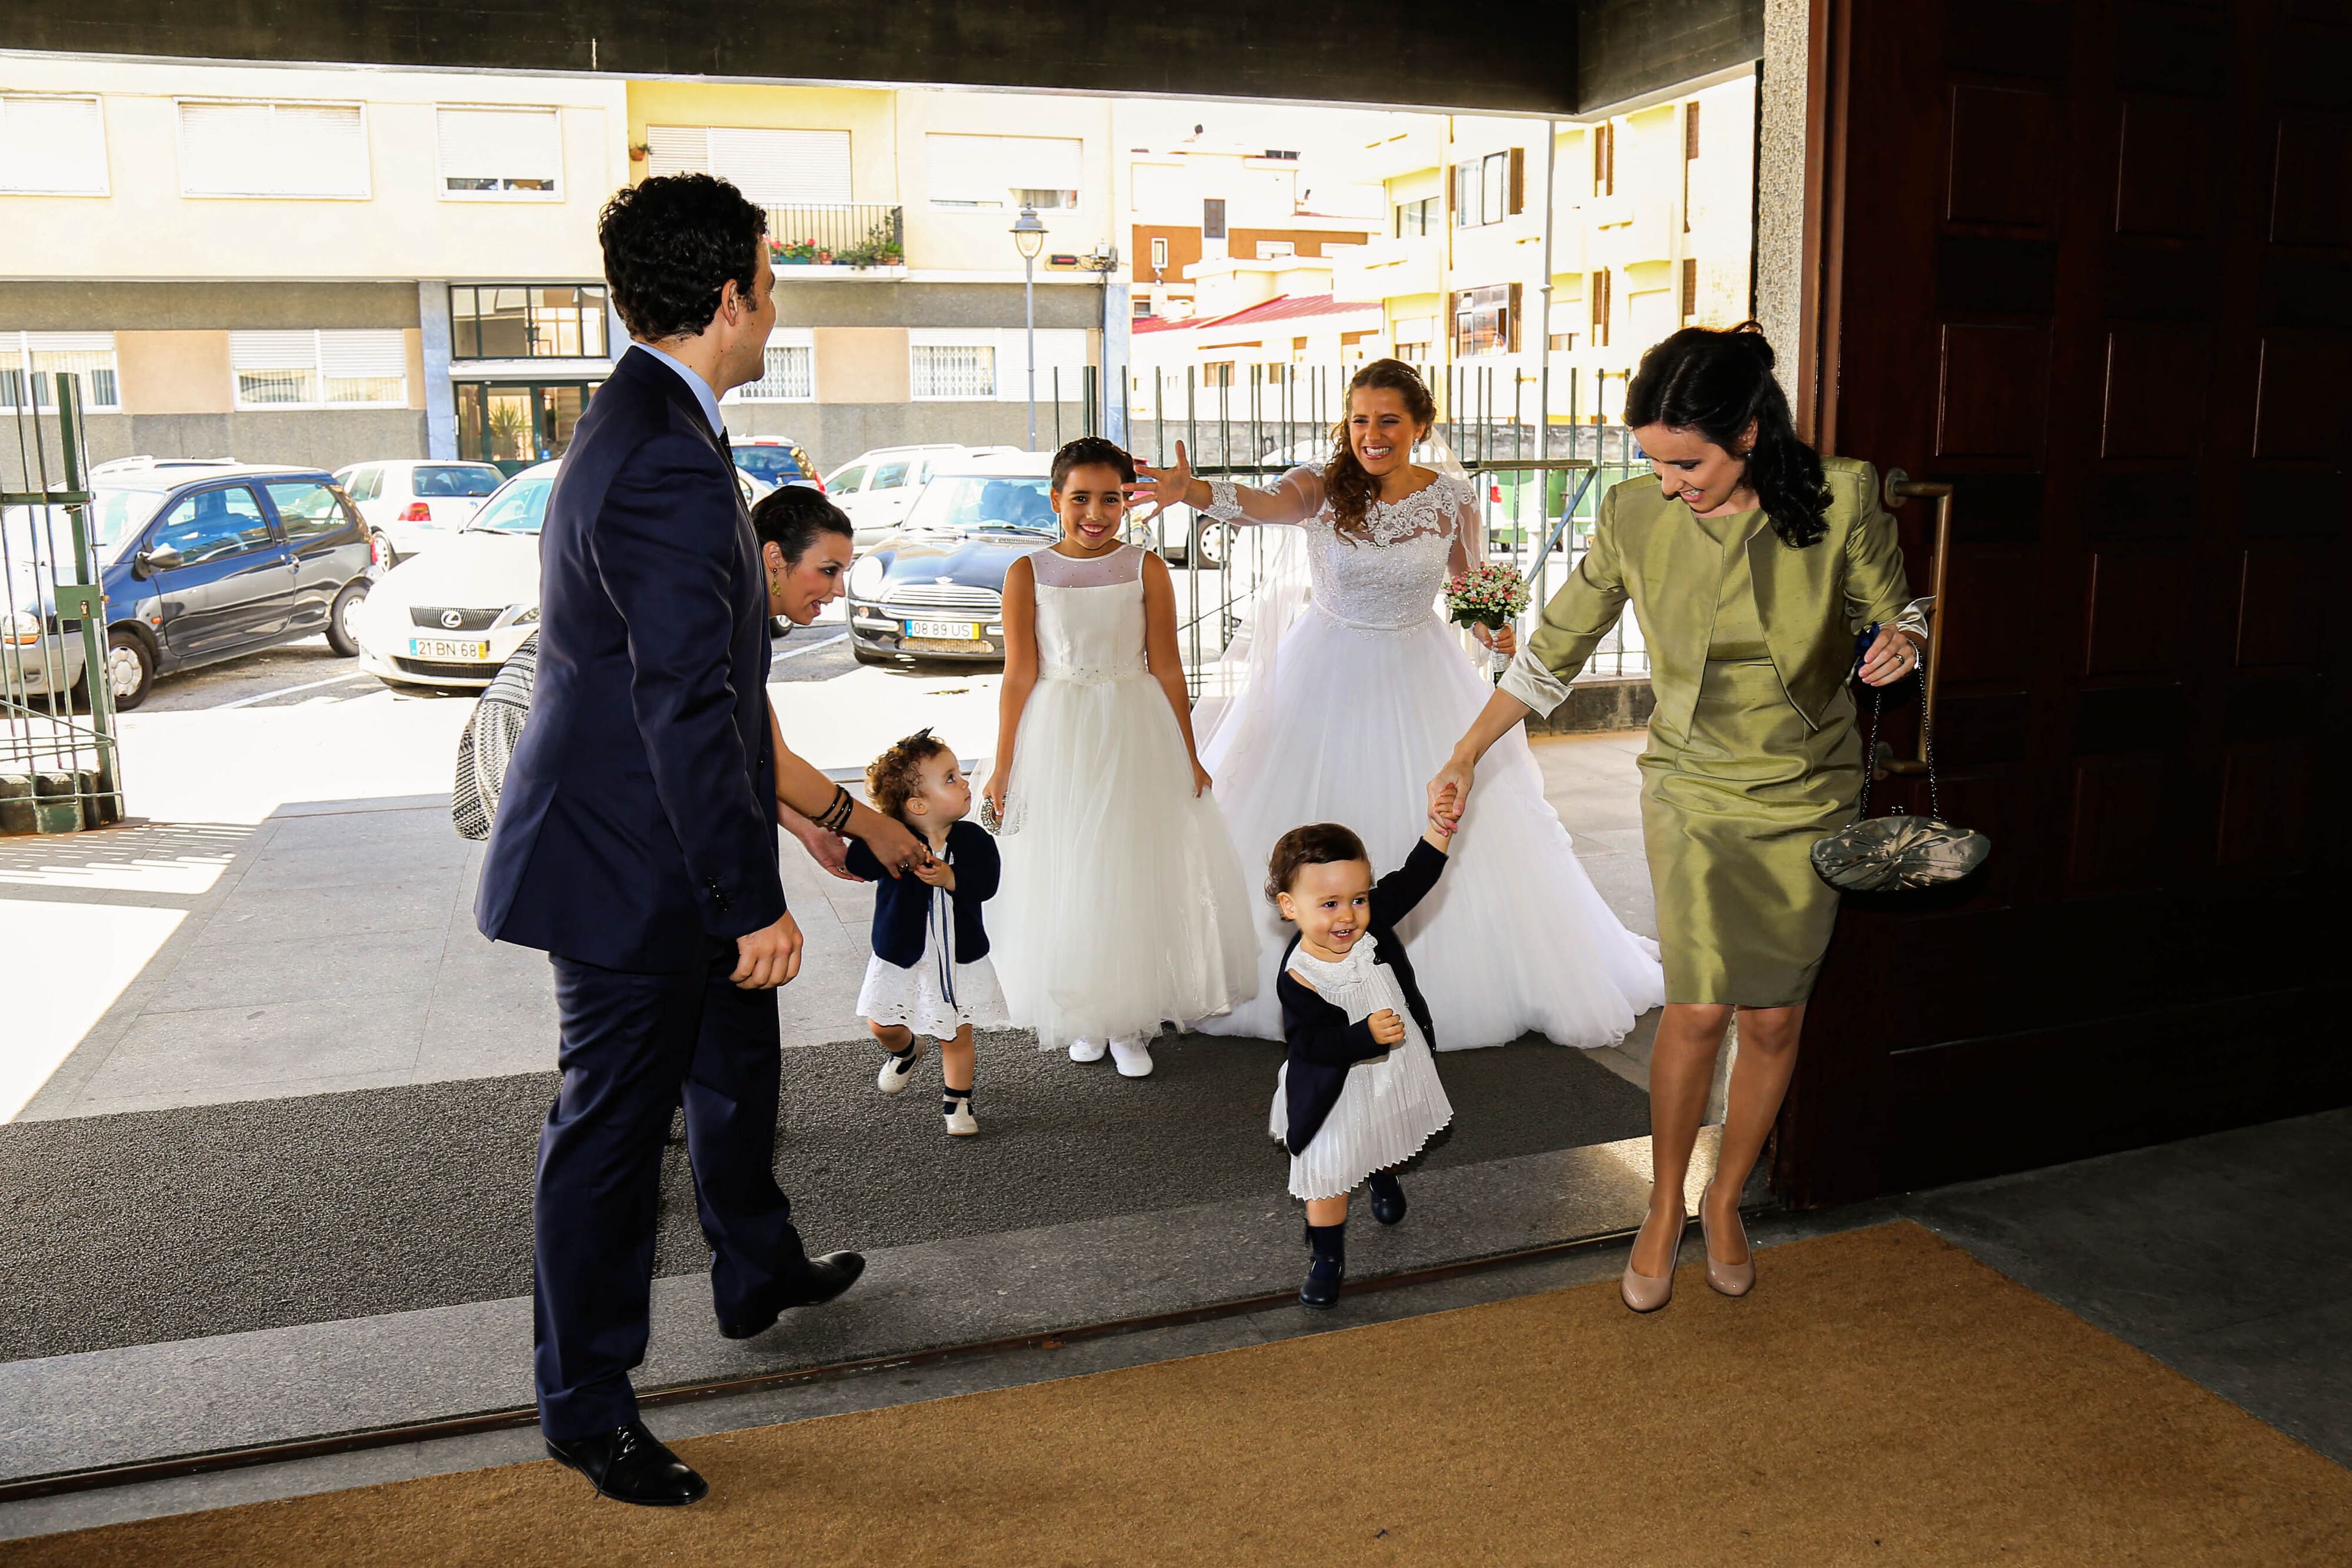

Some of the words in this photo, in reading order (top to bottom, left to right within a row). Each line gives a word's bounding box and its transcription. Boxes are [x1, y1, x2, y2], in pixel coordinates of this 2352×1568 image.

[914, 623, 928, 634] 08
[933, 624, 947, 636] 89
[951, 625, 970, 637] US
[419, 641, 431, 654] 21
[436, 643, 456, 656] BN
[461, 643, 476, 657] 68
